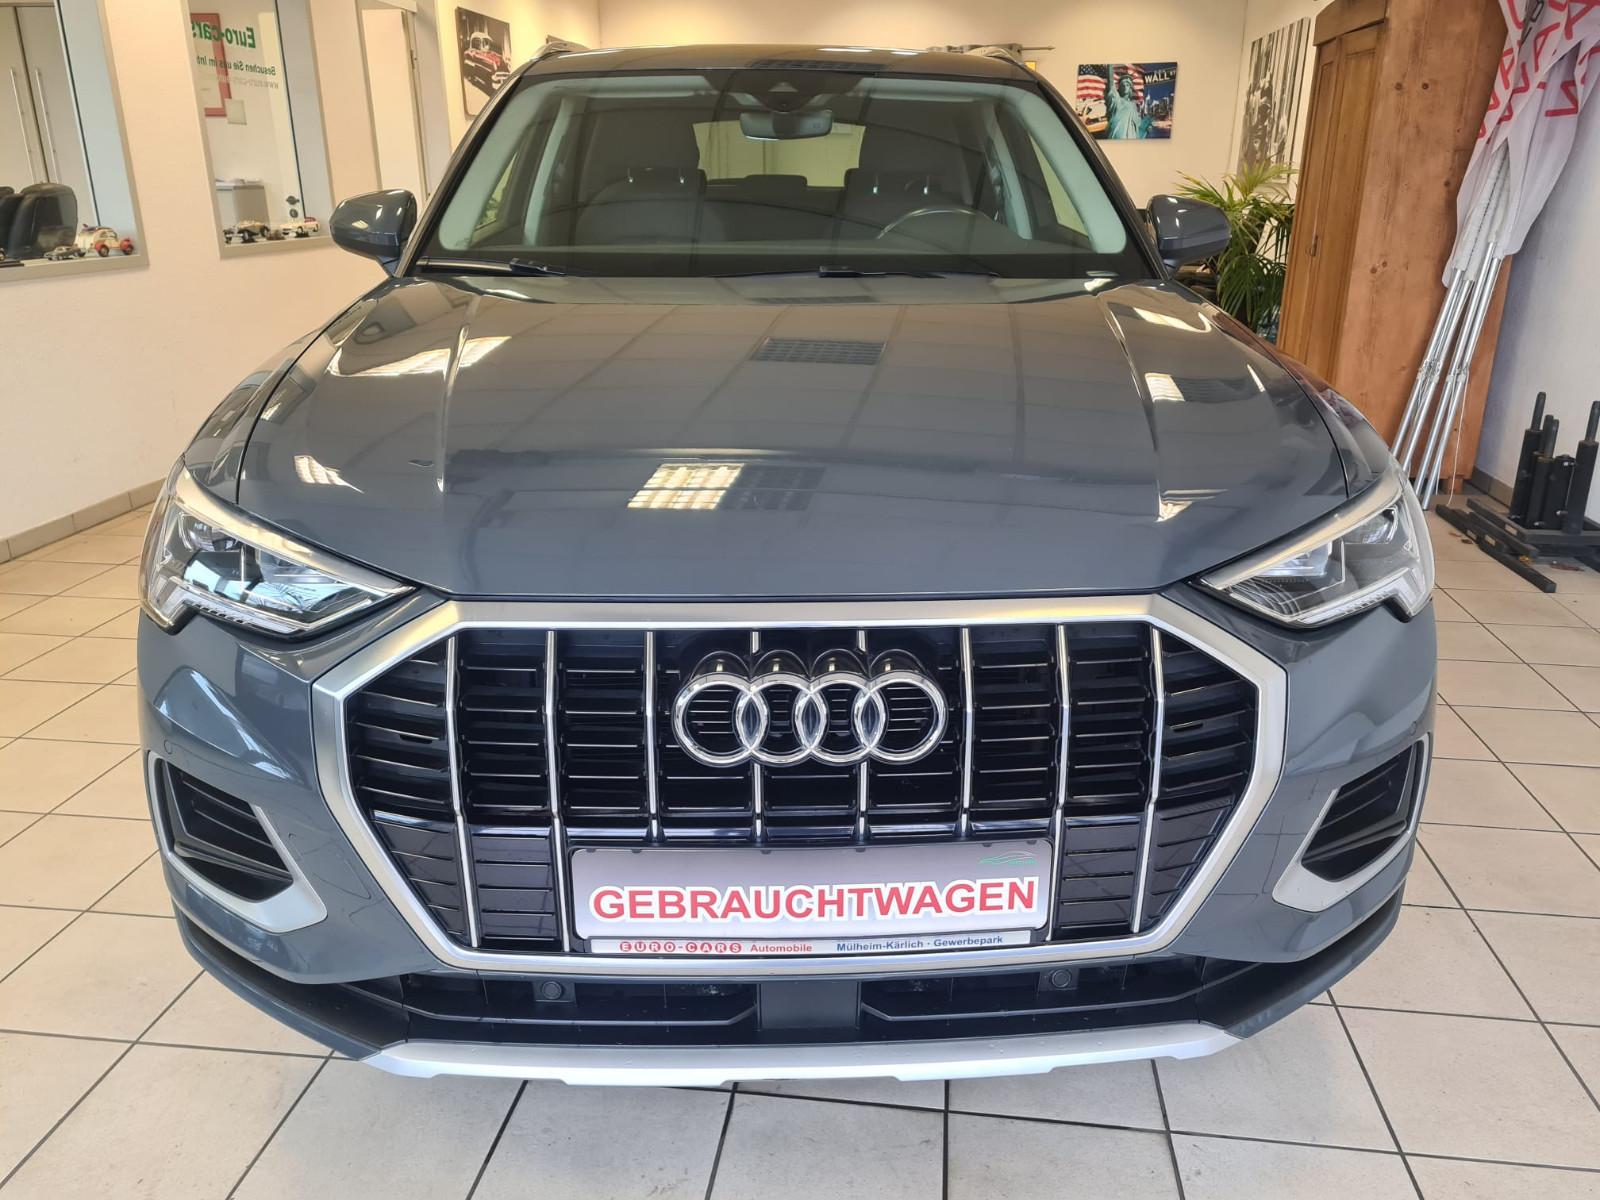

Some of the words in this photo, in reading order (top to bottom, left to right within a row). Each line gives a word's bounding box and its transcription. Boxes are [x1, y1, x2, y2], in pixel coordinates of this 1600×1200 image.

[1144, 71, 1170, 84] WALL
[591, 878, 1037, 920] GEBRAUCHTWAGEN
[620, 941, 742, 953] EURO-CARS
[750, 944, 813, 953] Automobile
[836, 939, 924, 952] Mülheim-Kärlich
[933, 935, 1004, 948] Gewerbepark
